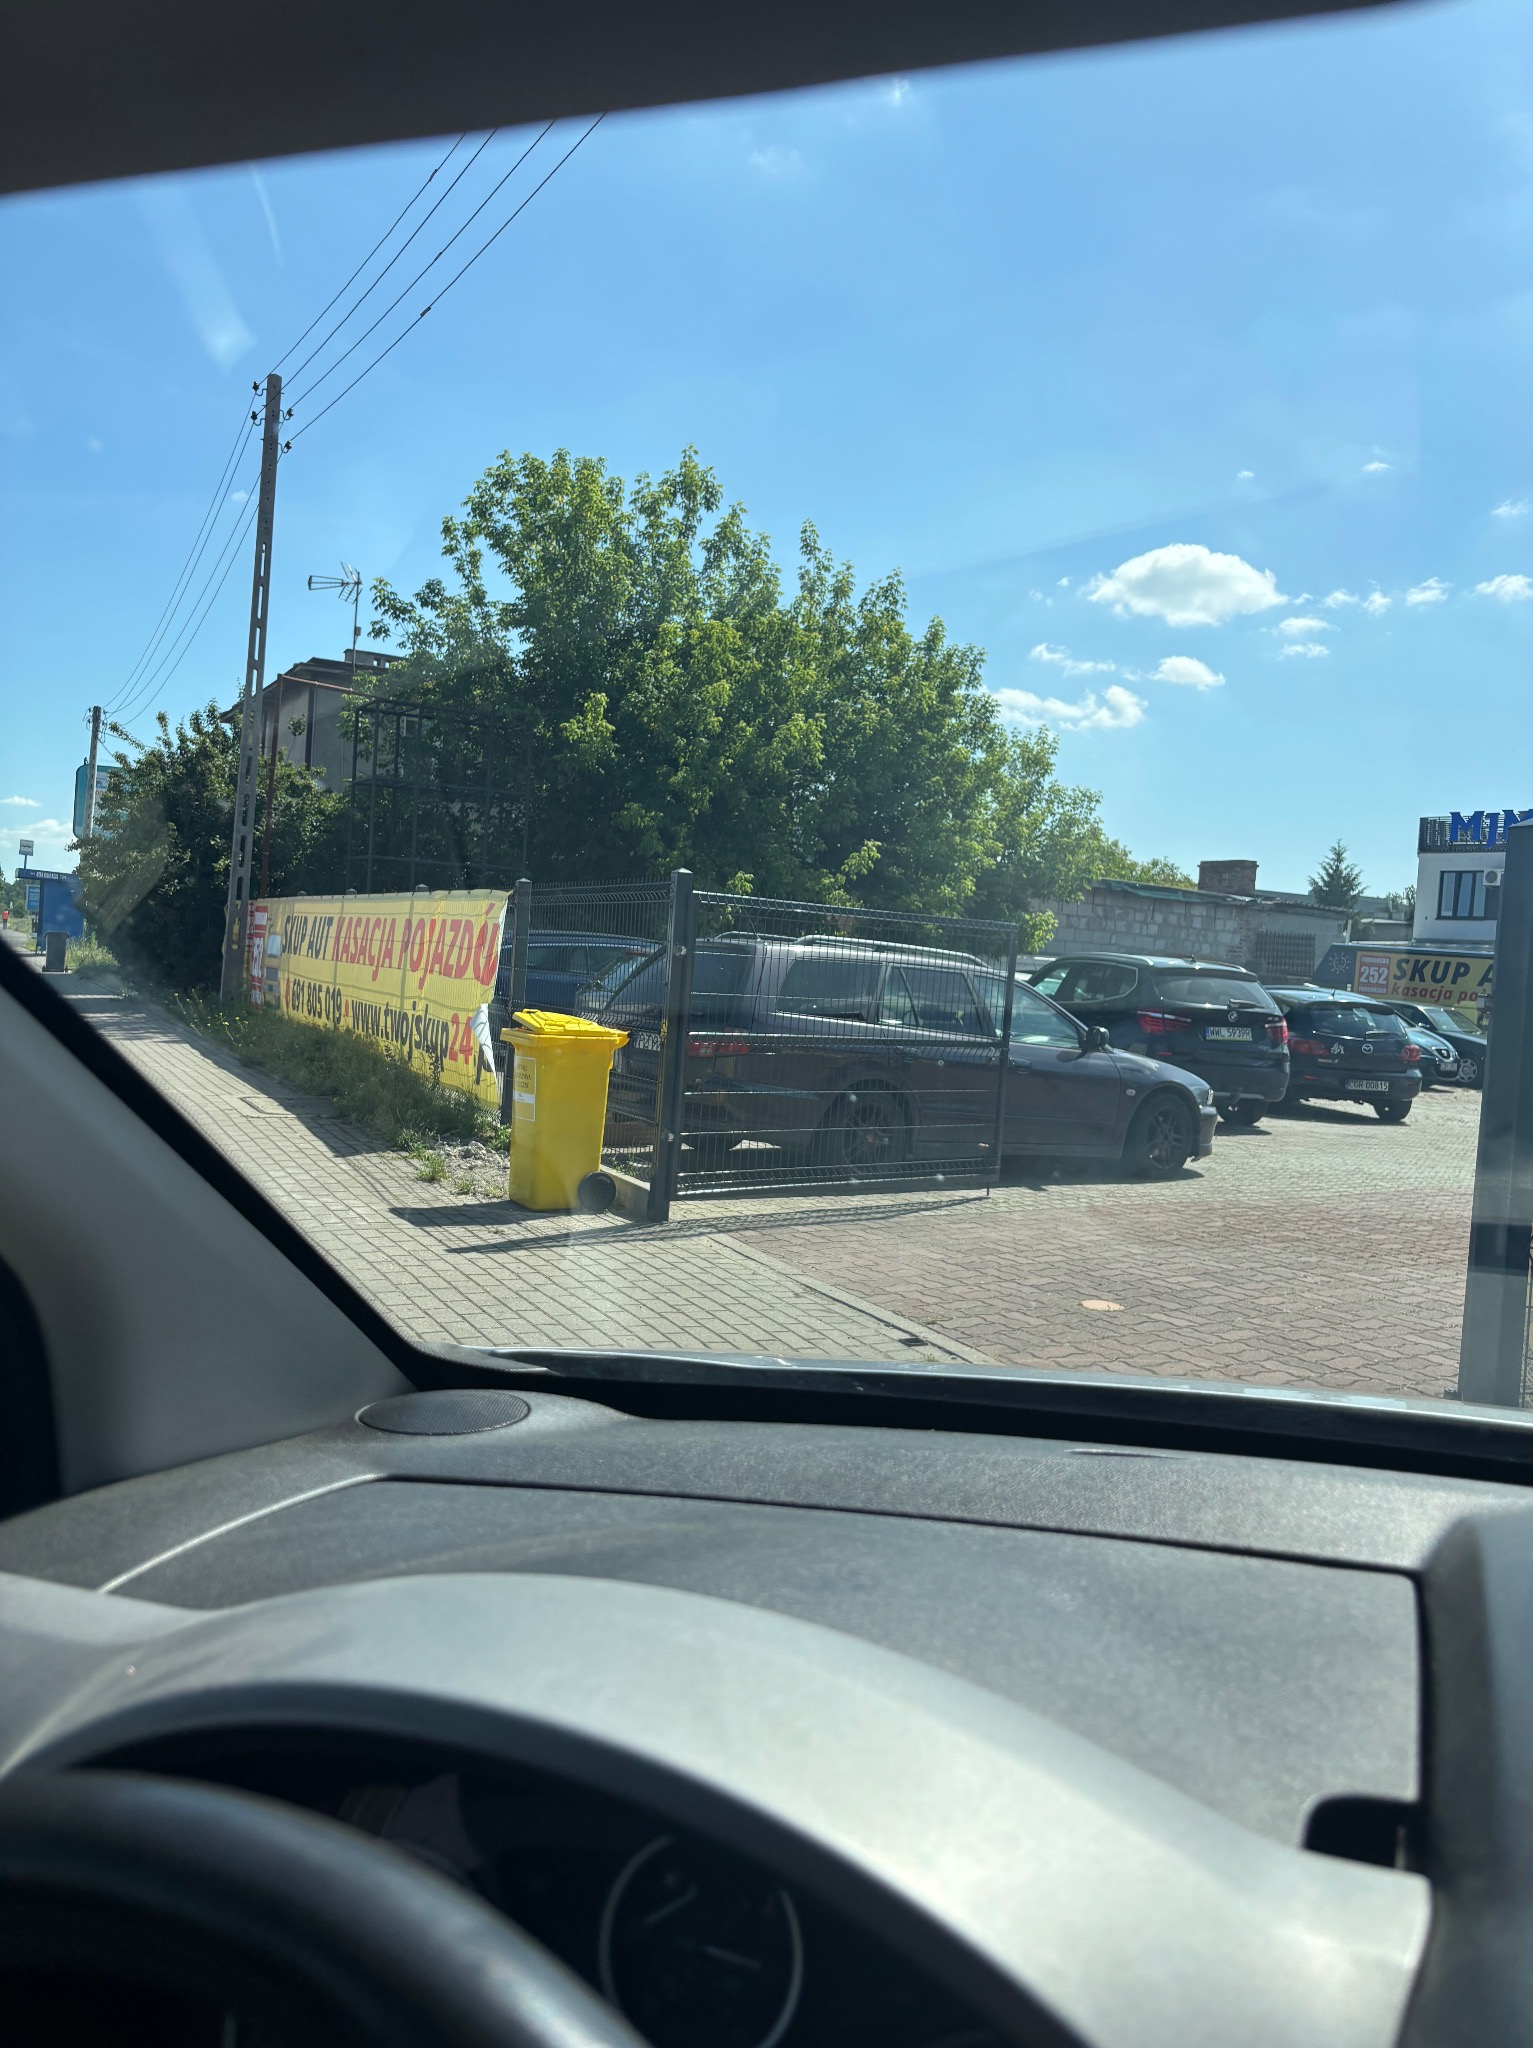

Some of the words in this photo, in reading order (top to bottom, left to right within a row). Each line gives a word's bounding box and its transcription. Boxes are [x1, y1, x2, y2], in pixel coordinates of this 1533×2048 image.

[281, 915, 308, 955] SKUP
[307, 916, 334, 960] AUT
[331, 916, 396, 982] KASACJA
[1359, 965, 1389, 985] 252
[1393, 958, 1471, 985] SKUP
[291, 978, 305, 1013] 691
[306, 981, 322, 1019] 805
[325, 985, 342, 1025] 019
[1390, 983, 1453, 1003] kasacja
[351, 999, 492, 1085] www.twojskup24.p
[1209, 1027, 1226, 1038] WWL
[1227, 1027, 1250, 1039] 5939R
